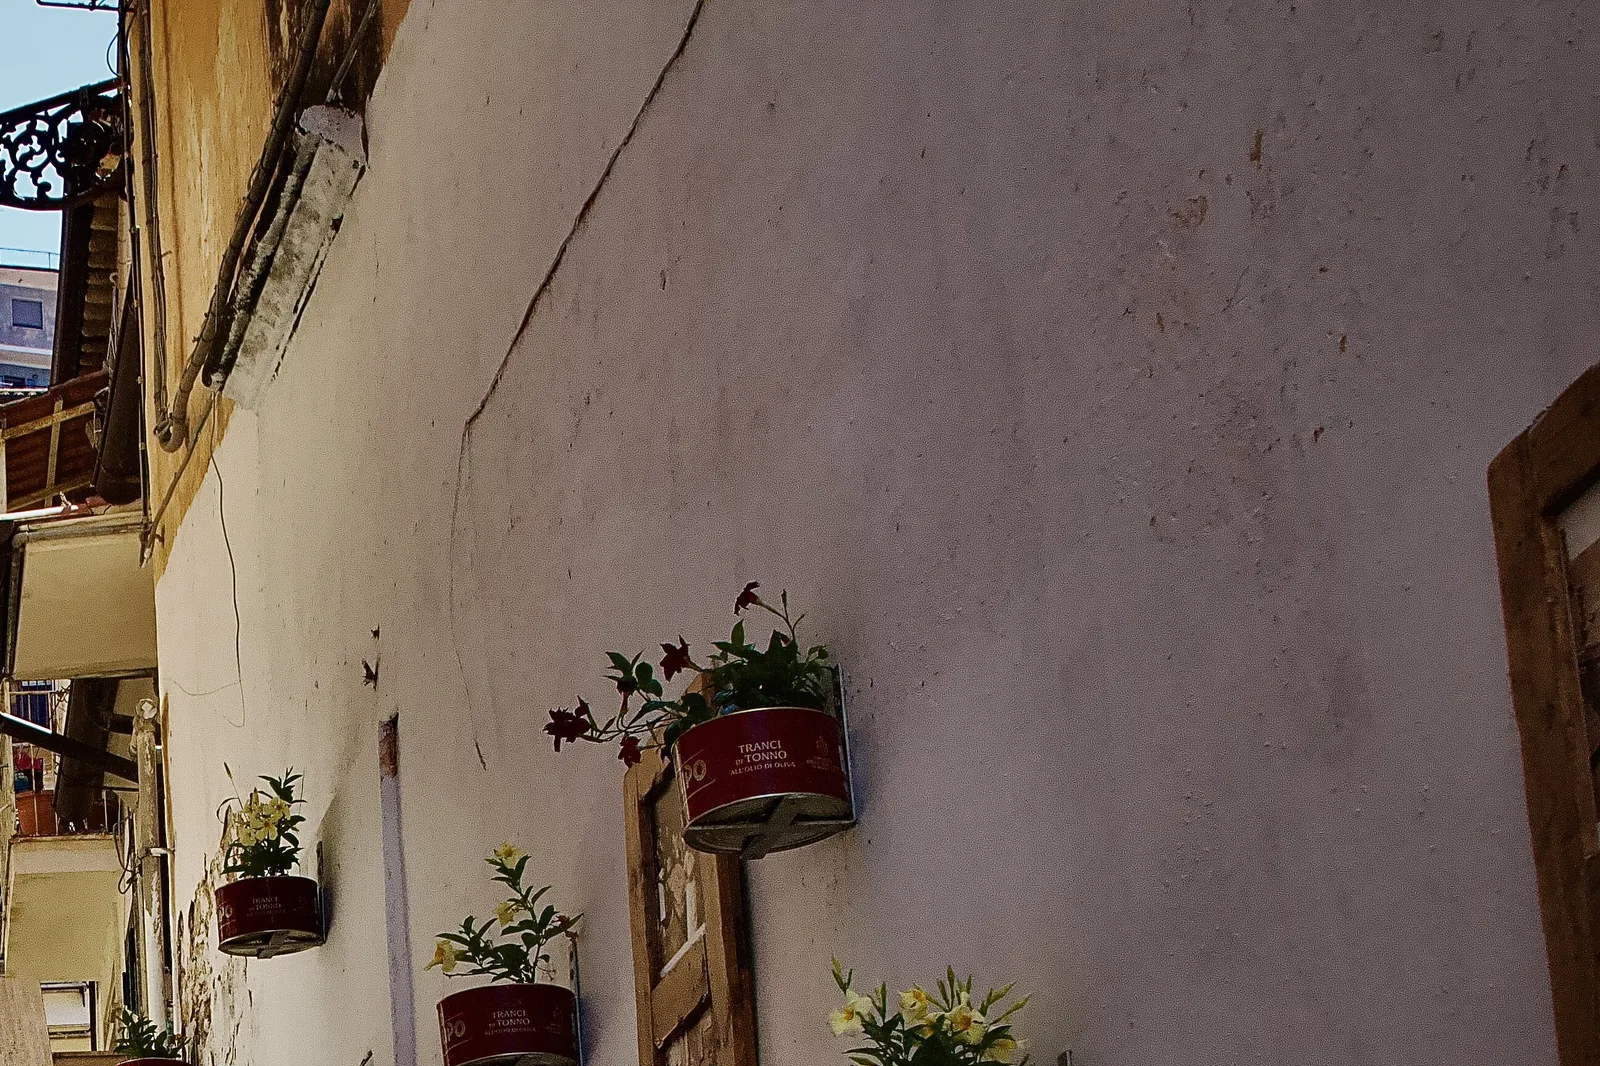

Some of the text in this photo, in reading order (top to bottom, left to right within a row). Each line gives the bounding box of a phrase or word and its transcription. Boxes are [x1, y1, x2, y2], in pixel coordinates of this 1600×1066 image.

[738, 739, 782, 754] TRANCI
[744, 750, 788, 764] TONNO
[492, 1009, 526, 1019] TRANCI
[496, 1018, 530, 1027] TONNO
